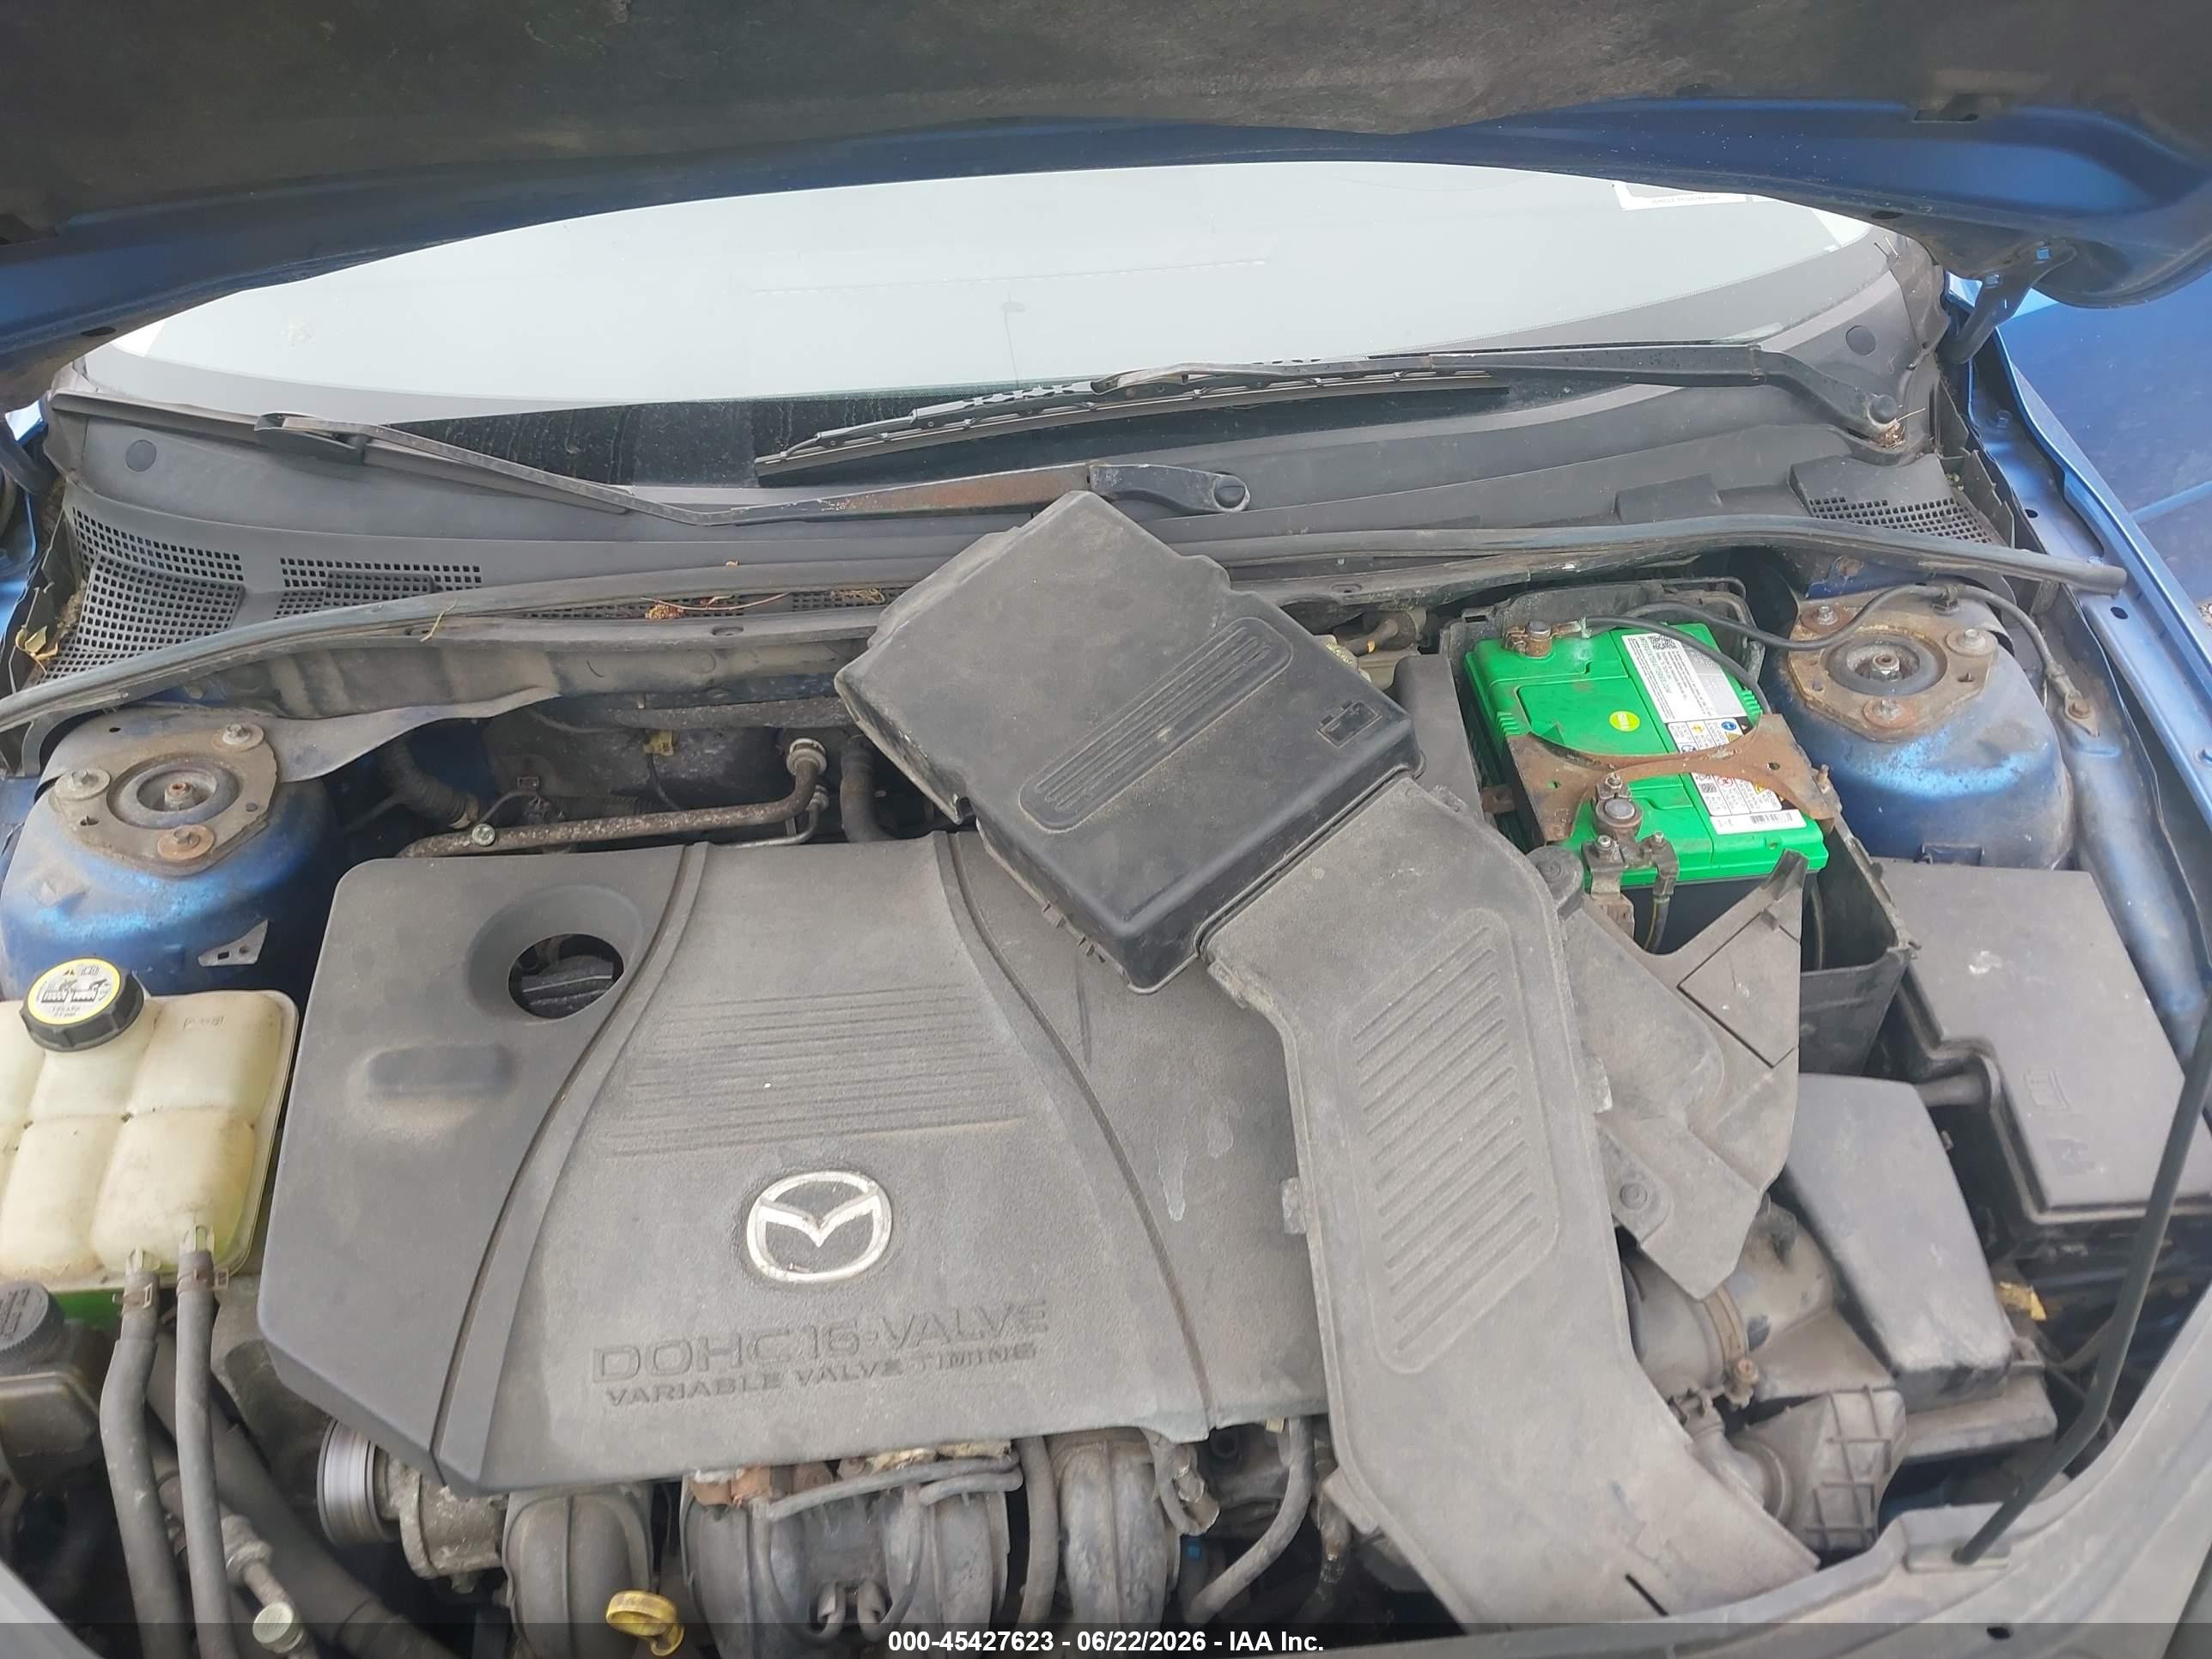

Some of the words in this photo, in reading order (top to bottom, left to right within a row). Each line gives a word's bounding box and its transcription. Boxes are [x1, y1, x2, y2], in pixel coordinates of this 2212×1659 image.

[592, 1328, 790, 1383] DOHC
[605, 1374, 781, 1407] VARIABLE
[794, 1359, 902, 1388] VALVE
[911, 1342, 1037, 1371] TIMING
